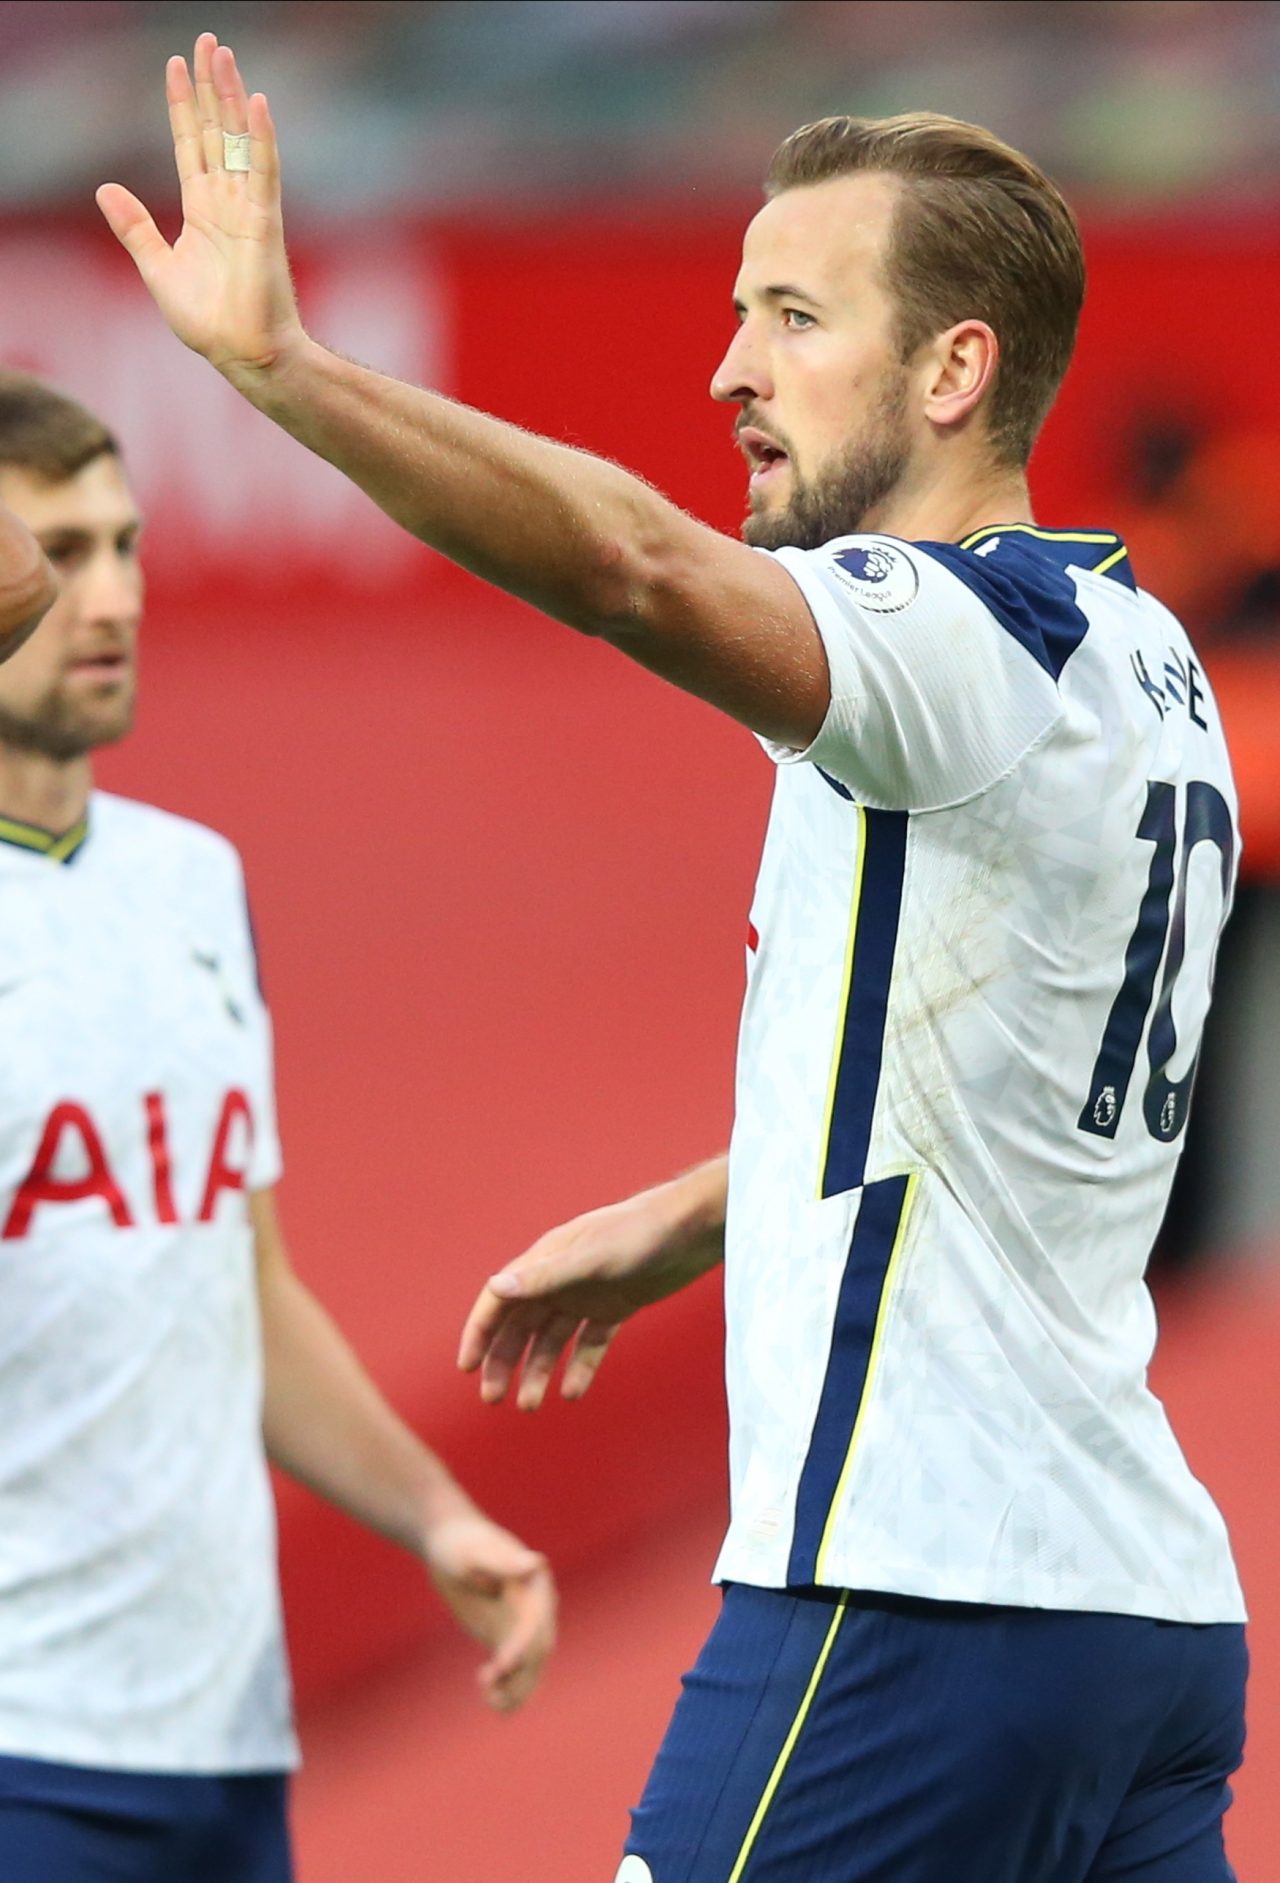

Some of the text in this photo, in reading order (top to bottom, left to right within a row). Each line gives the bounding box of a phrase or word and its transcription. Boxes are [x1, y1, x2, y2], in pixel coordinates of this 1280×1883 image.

[1129, 647, 1208, 733] KNE
[1076, 780, 1234, 1143] 10
[0, 1086, 255, 1241] AIA
